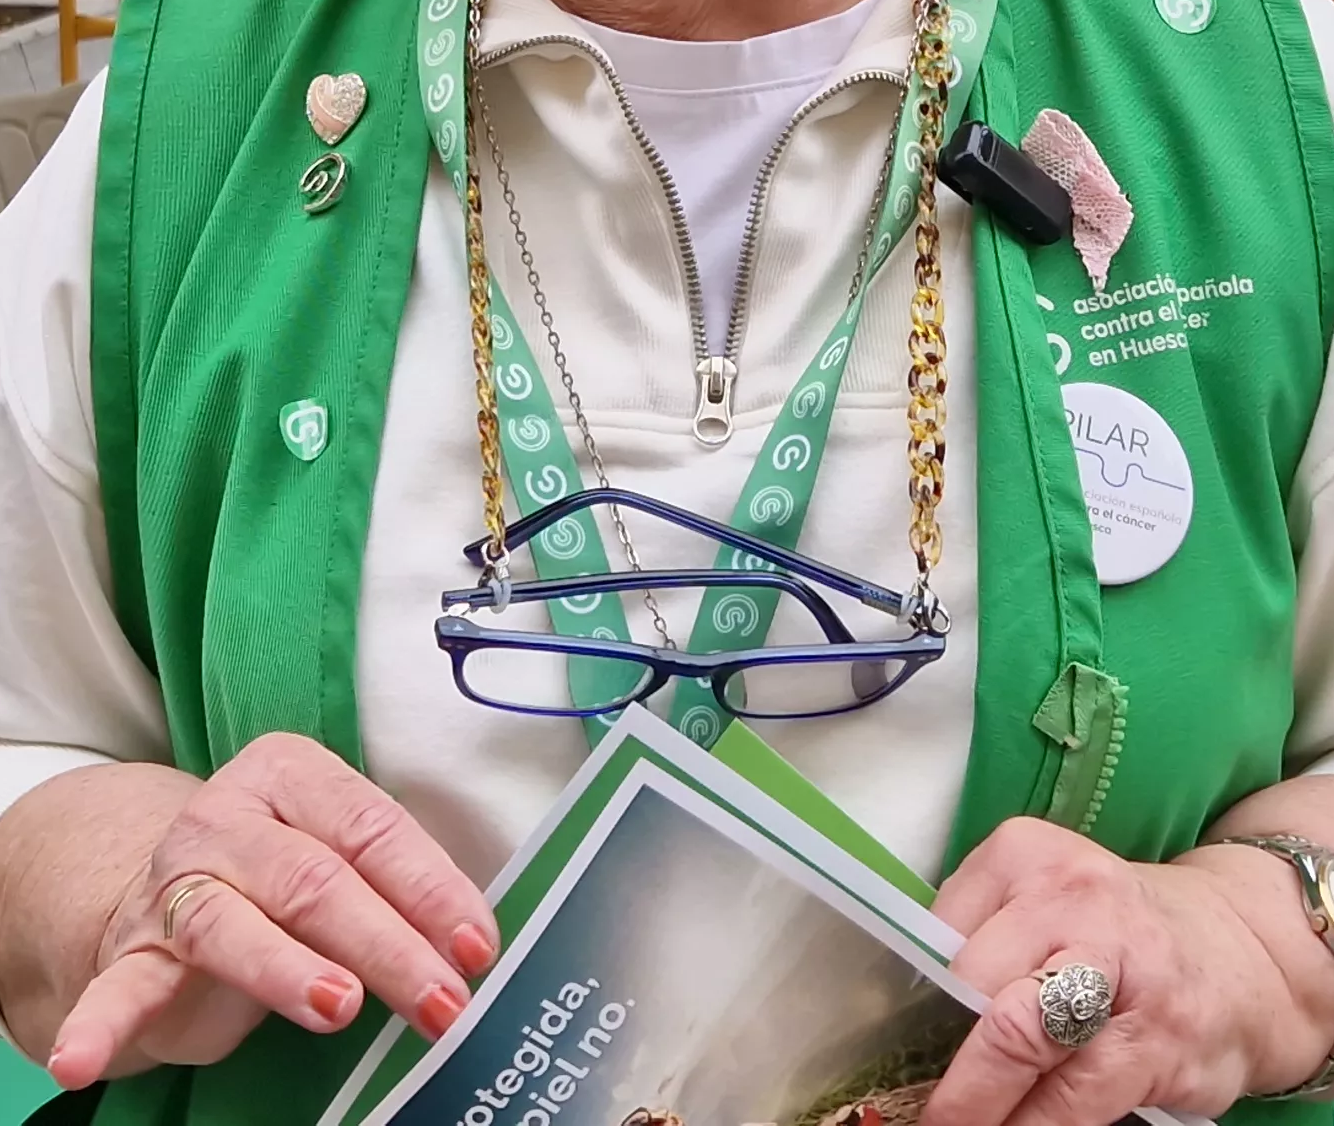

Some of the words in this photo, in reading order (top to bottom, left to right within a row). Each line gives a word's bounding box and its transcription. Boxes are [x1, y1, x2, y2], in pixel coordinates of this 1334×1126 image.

[1073, 273, 1177, 314] asociació
[1176, 274, 1254, 308] pañola
[1080, 308, 1154, 340] contra
[1158, 300, 1180, 321] el
[1088, 348, 1117, 366] en
[1119, 331, 1189, 360] Huesc
[1129, 503, 1183, 525] española
[577, 998, 637, 1059] no.
[456, 978, 601, 1126] otegida,
